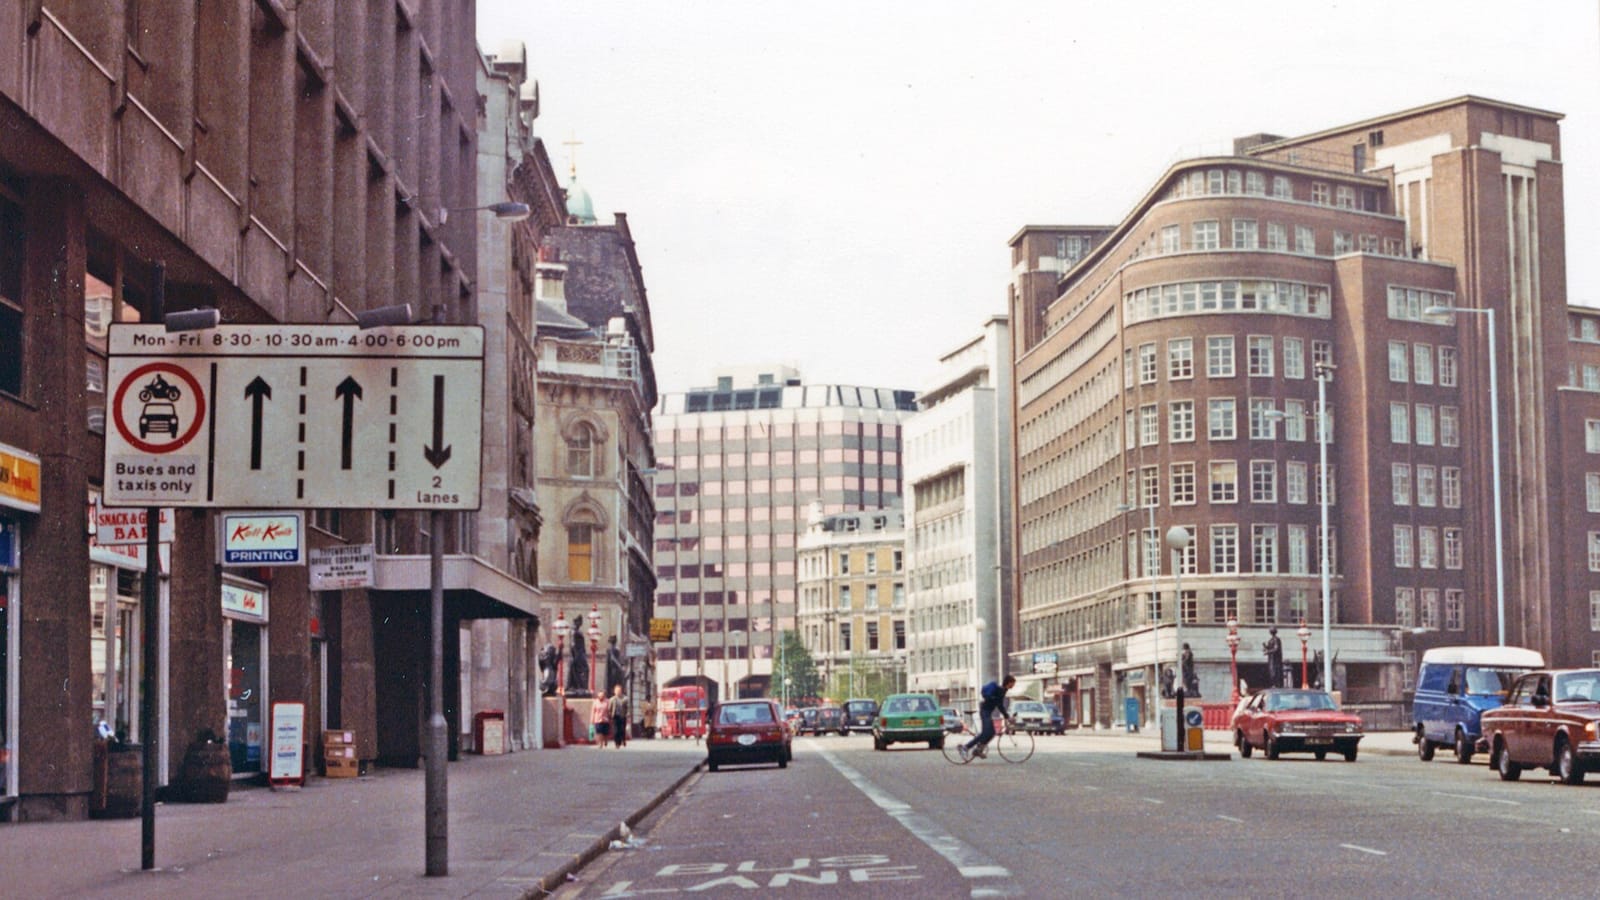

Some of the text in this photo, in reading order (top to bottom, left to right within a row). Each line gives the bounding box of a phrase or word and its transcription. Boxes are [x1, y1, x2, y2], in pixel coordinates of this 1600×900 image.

[133, 334, 165, 346] Mon
[179, 334, 200, 346] Fri
[116, 462, 196, 475] Buses and
[118, 480, 192, 494] taxis only
[432, 475, 442, 489] 2
[417, 490, 459, 504] lanes
[98, 513, 129, 526] SNACK
[230, 550, 294, 560] PRINTING
[655, 854, 891, 877] BUS
[600, 865, 924, 899] LANE
